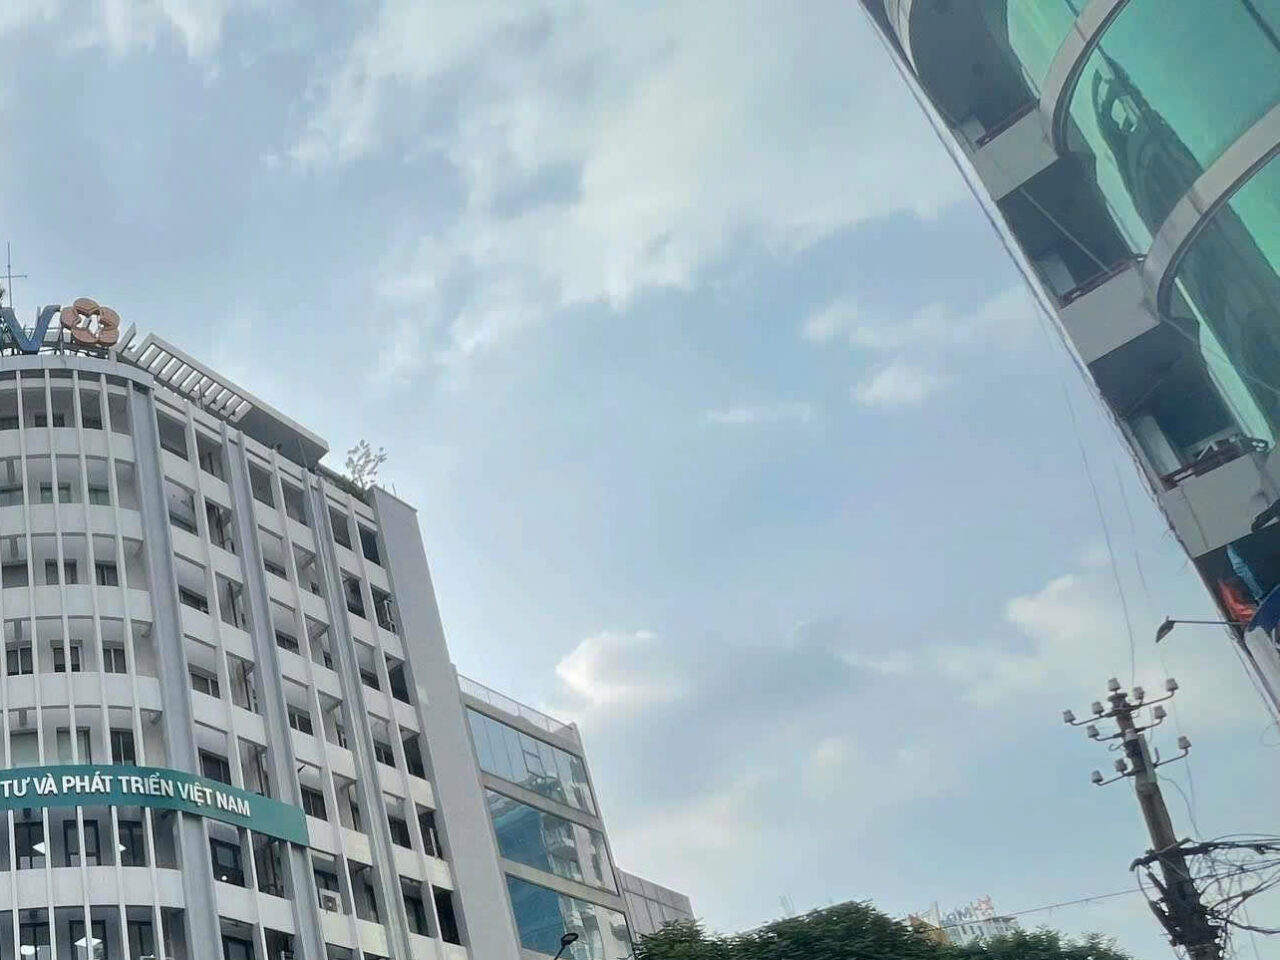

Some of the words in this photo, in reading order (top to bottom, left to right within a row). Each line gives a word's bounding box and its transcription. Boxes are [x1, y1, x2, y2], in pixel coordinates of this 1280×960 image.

[0, 776, 31, 798] TƯ
[33, 773, 58, 795] VÀ
[62, 771, 113, 793] PHÁT
[118, 771, 174, 797] TRIỂN
[177, 781, 213, 806] VIỆT
[215, 791, 250, 817] NAM
